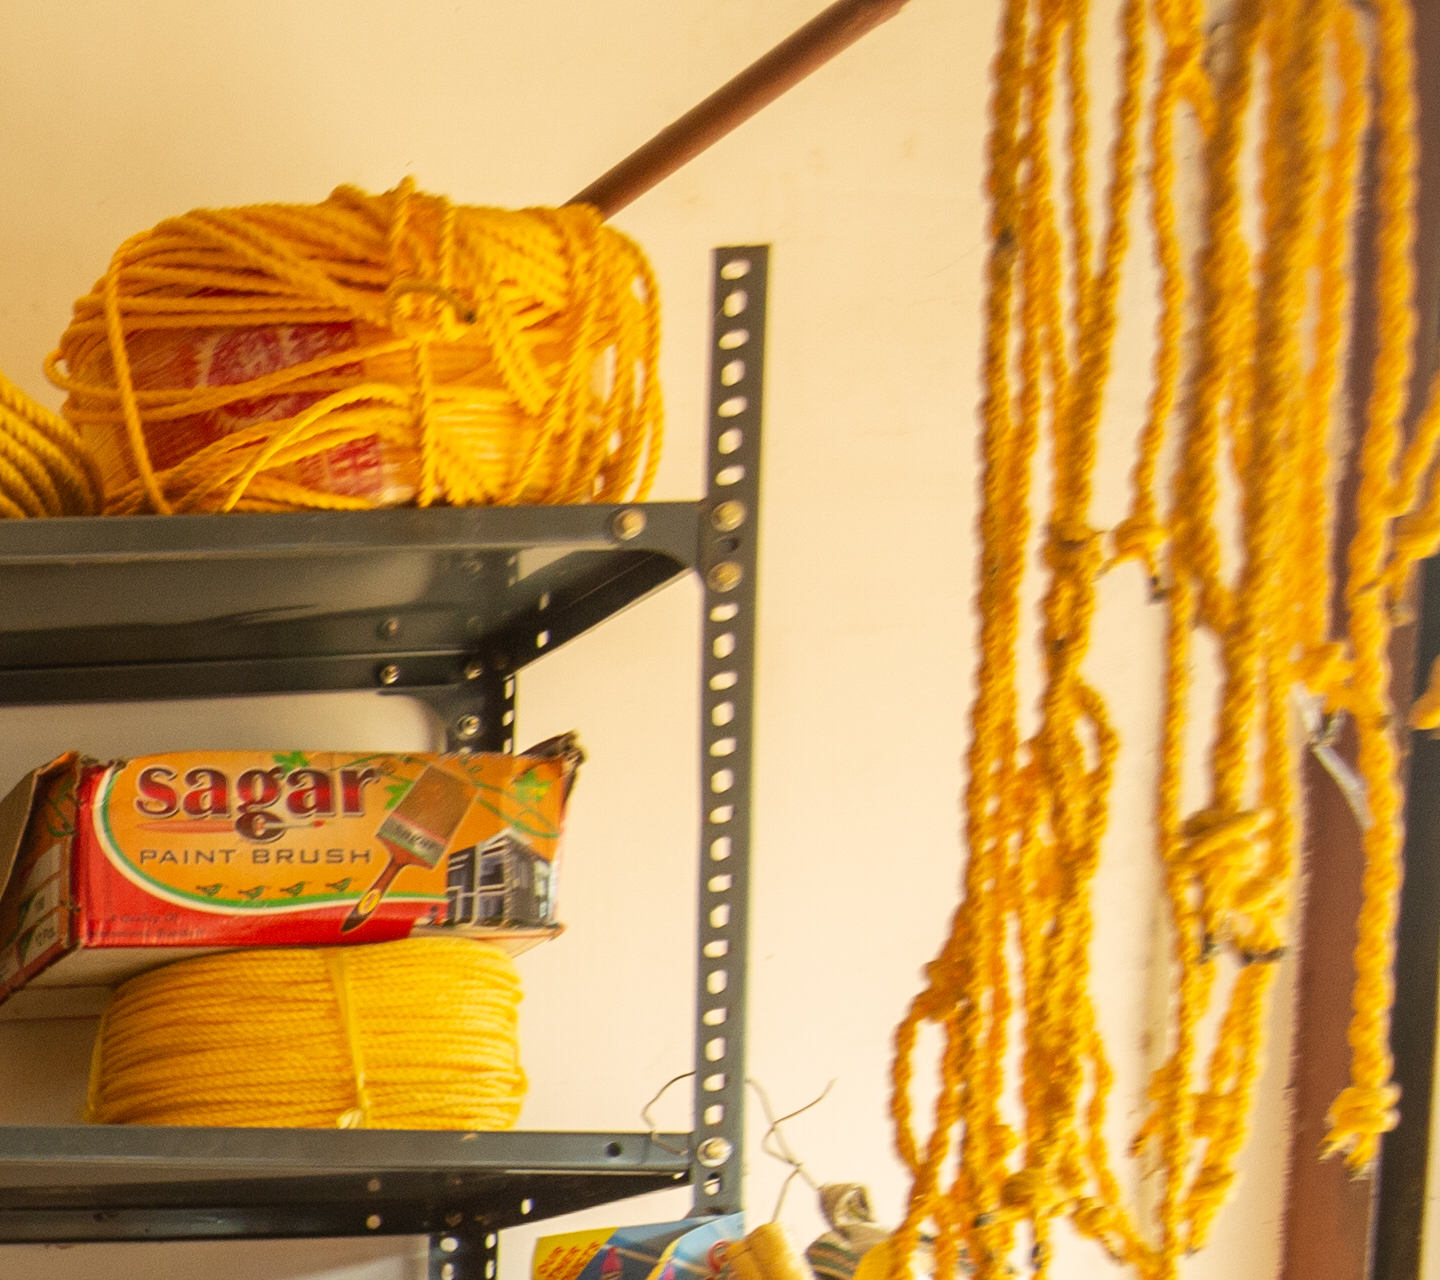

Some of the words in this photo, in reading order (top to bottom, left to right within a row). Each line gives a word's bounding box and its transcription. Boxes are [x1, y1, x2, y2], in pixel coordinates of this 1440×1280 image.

[135, 764, 380, 843] sagar
[138, 848, 238, 866] PAINT
[251, 847, 372, 866] BRUSH
